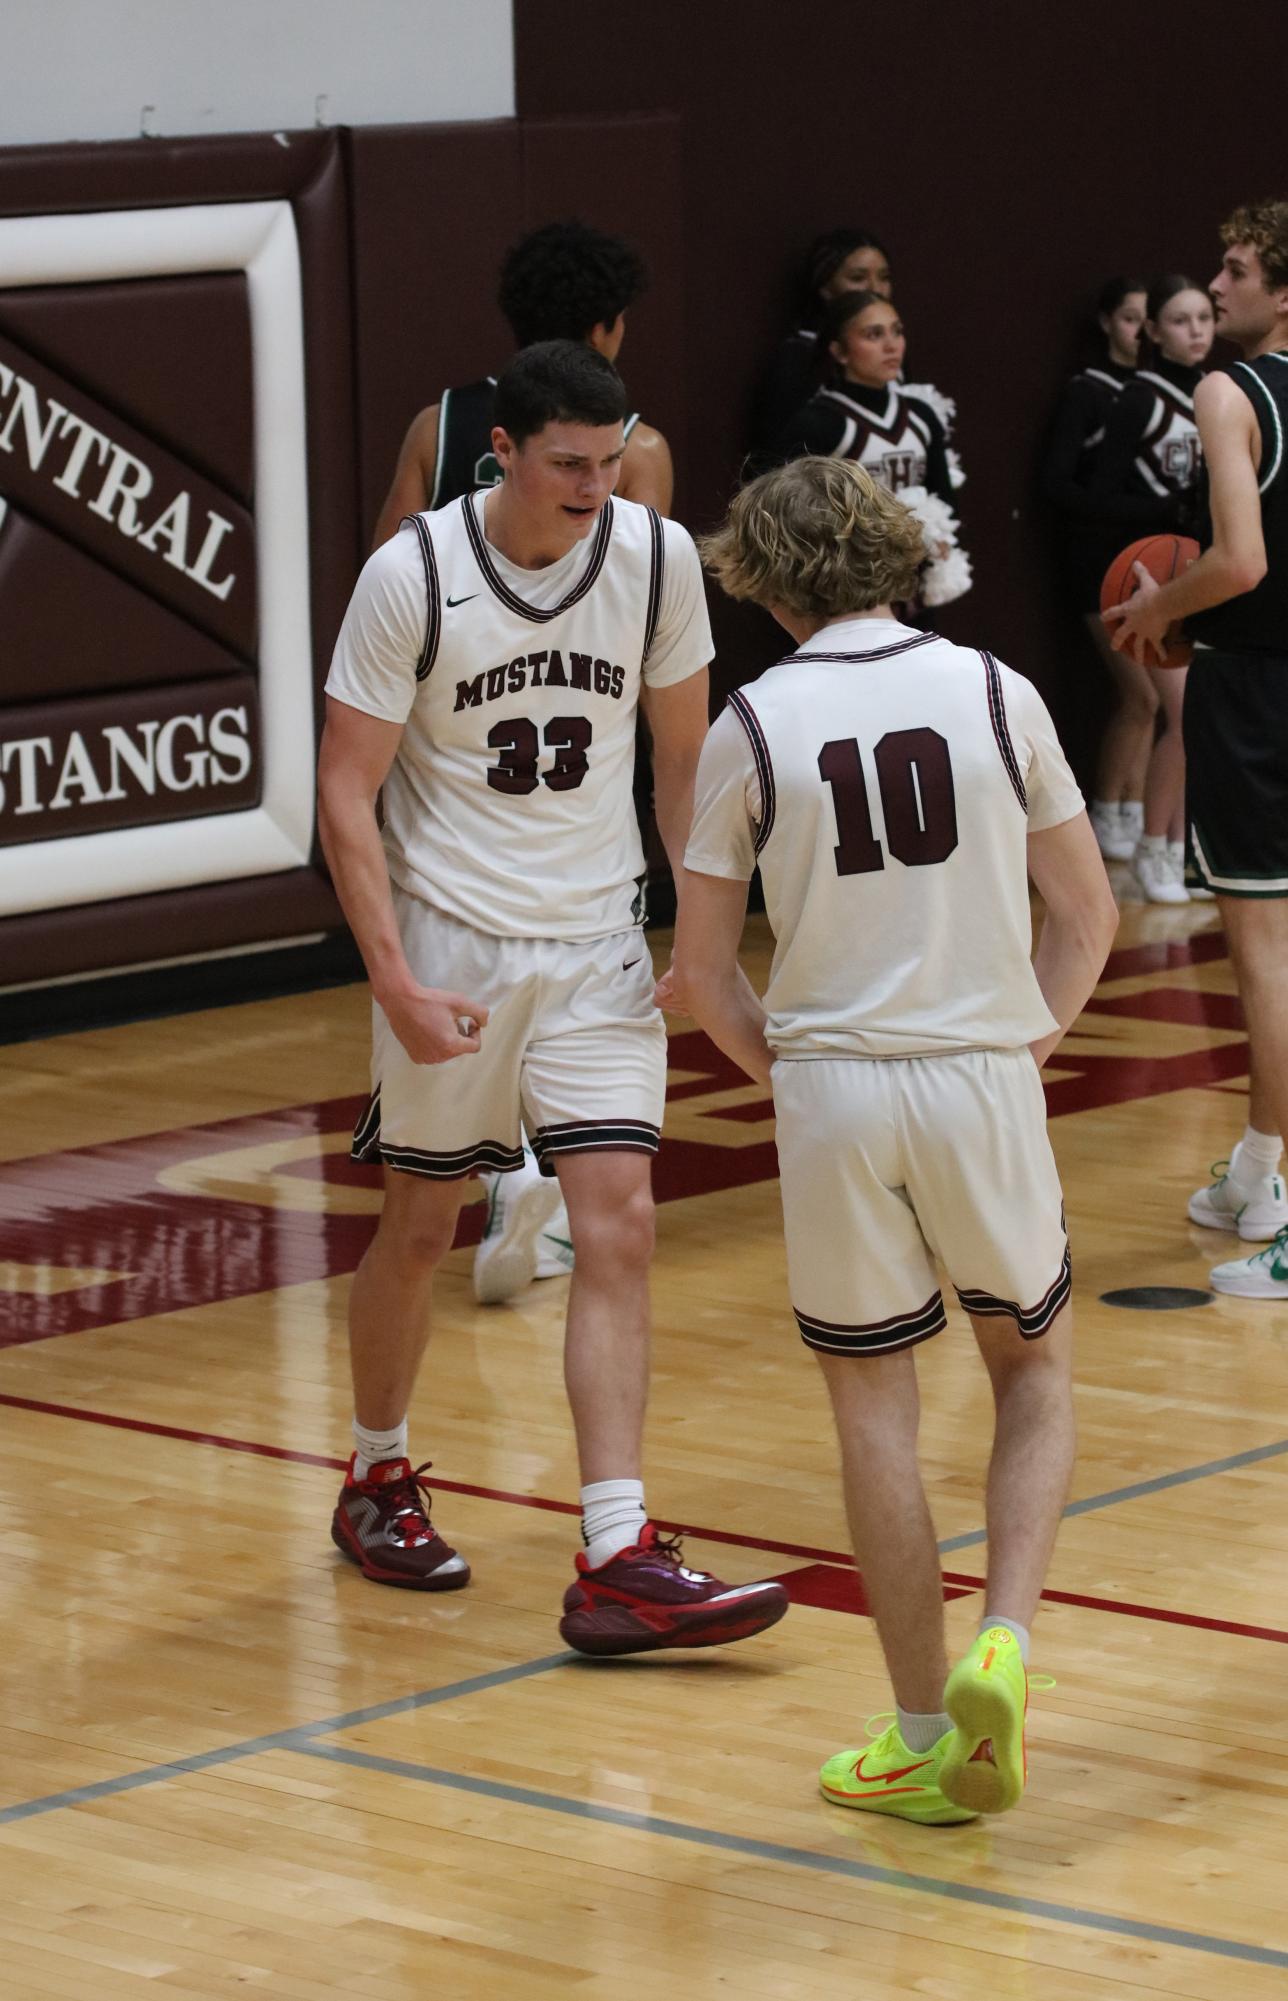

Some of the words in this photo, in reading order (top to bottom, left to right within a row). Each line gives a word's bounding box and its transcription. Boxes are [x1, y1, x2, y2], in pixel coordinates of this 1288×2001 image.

[453, 649, 626, 713] MUSTANGS
[0, 705, 251, 815] TANGS
[486, 715, 593, 796] 33
[817, 726, 959, 877] 10
